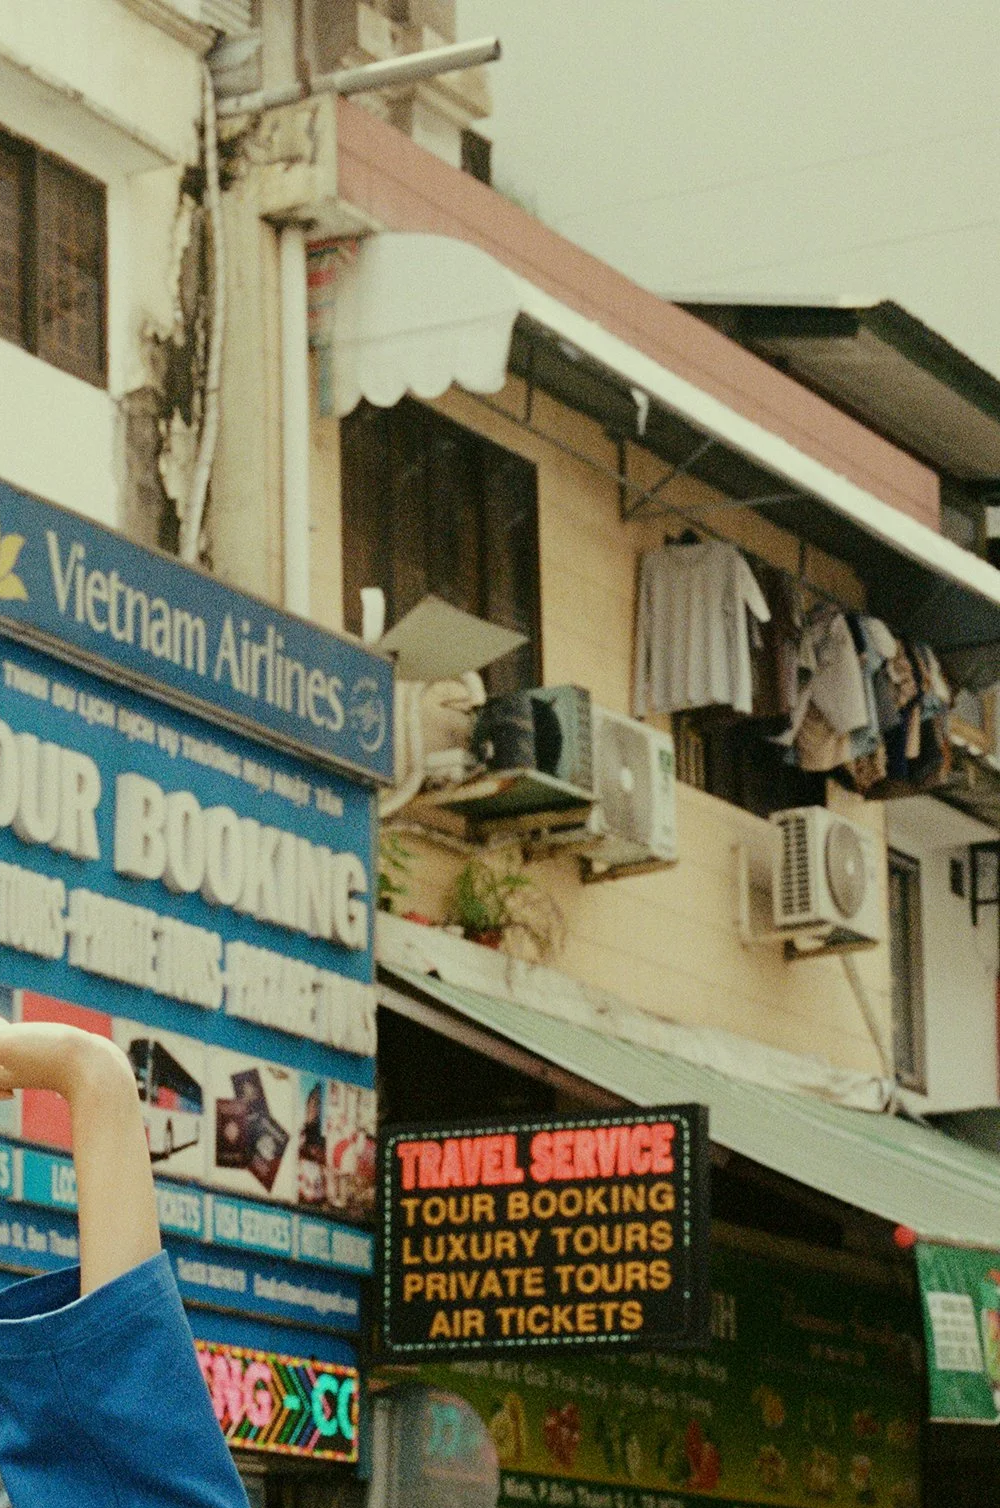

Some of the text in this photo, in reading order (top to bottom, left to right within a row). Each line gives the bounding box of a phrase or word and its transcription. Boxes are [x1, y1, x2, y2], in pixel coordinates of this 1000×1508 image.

[46, 529, 345, 732] Vietnam Airlines
[114, 771, 368, 951] BOOKING
[397, 1122, 676, 1191] TRAVEL SERVICE
[400, 1182, 676, 1227] TOUR BOOKING
[402, 1220, 674, 1266] LUXURY TOURS
[403, 1267, 547, 1303] PRIVATE
[554, 1259, 673, 1296] TOURS
[428, 1300, 645, 1339] AIR TICKETS
